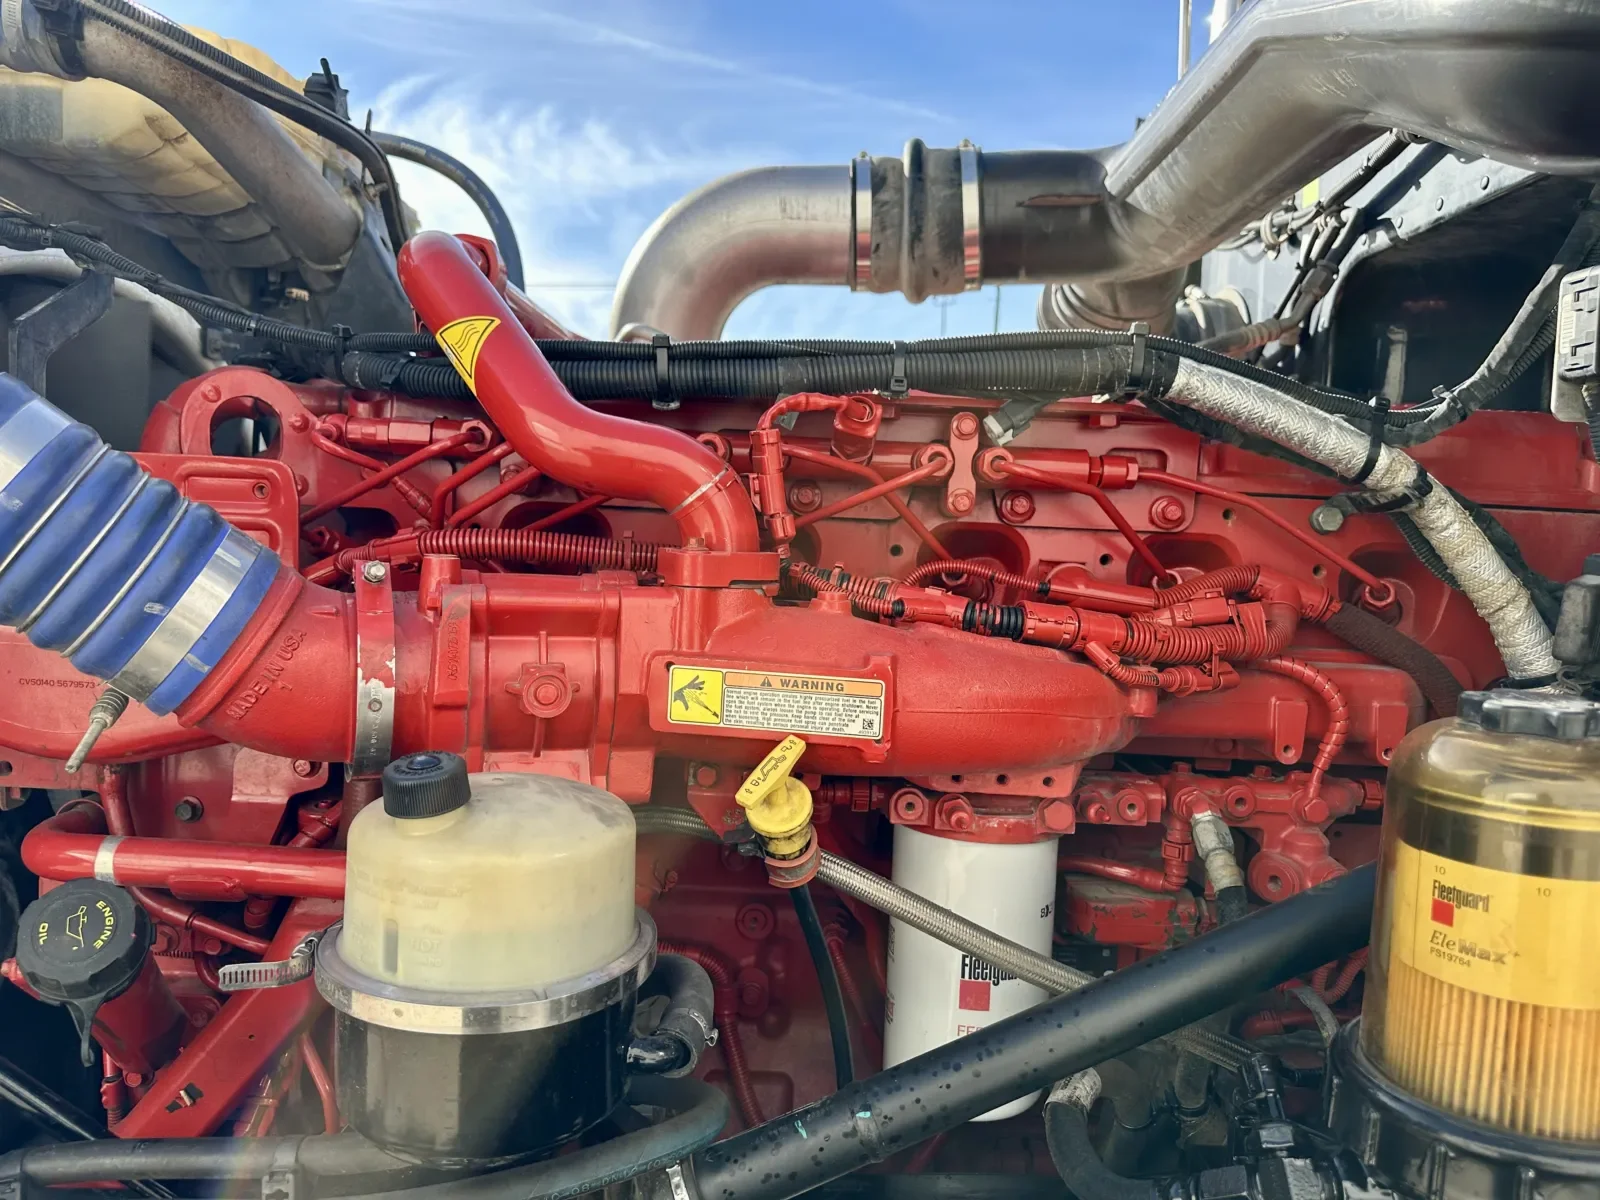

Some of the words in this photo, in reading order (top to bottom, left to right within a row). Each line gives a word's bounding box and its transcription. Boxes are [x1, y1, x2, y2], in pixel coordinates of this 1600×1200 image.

[57, 680, 96, 689] 5679573
[226, 681, 269, 720] MADE
[261, 660, 284, 682] IN
[276, 629, 307, 661] USA
[780, 679, 845, 691] WARNING
[1434, 865, 1446, 875] 10
[1432, 879, 1490, 913] Fleetguard
[1536, 887, 1551, 897] 10
[39, 923, 49, 945] OIL
[93, 900, 114, 949] ENGINE
[1429, 946, 1471, 968] FS19764
